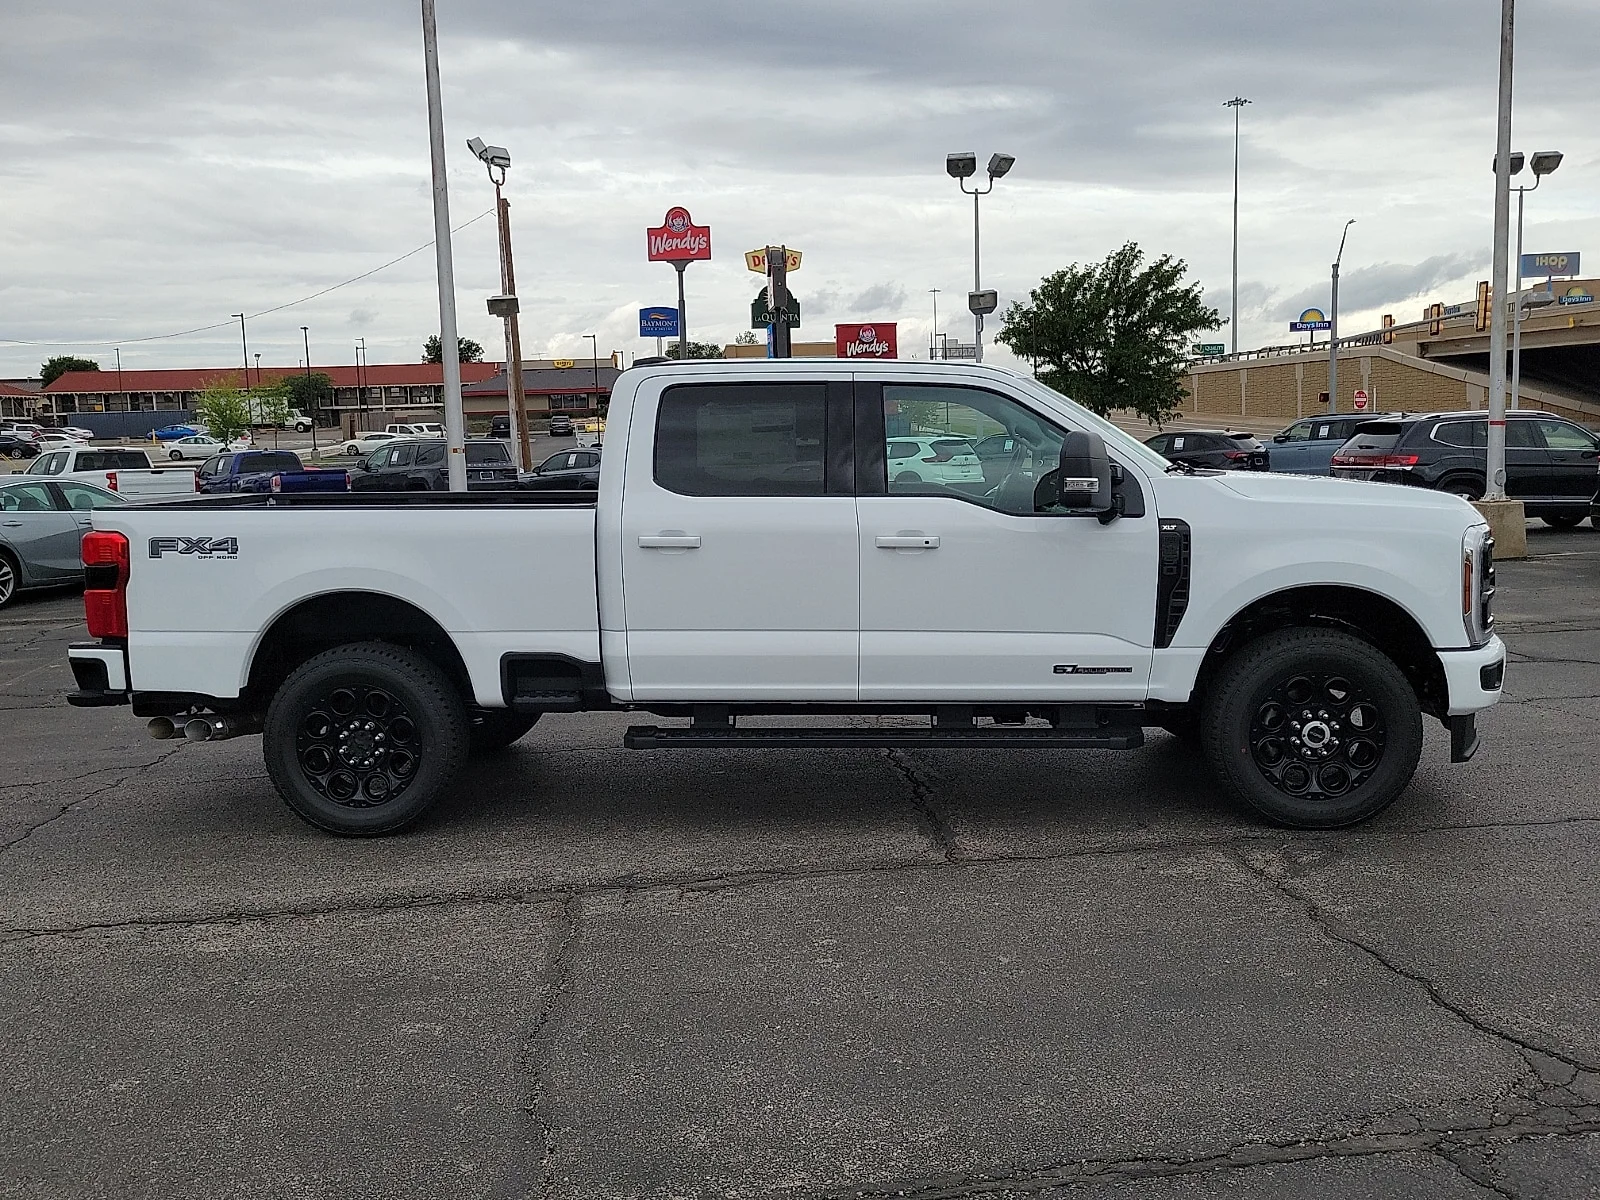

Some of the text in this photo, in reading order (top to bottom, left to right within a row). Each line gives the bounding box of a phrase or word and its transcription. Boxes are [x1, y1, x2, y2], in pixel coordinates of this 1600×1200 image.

[651, 230, 708, 256] Wendy's
[1535, 255, 1568, 269] IHOP
[641, 319, 678, 327] BAYMONT
[846, 338, 889, 357] Wendy's
[148, 536, 239, 559] FX4
